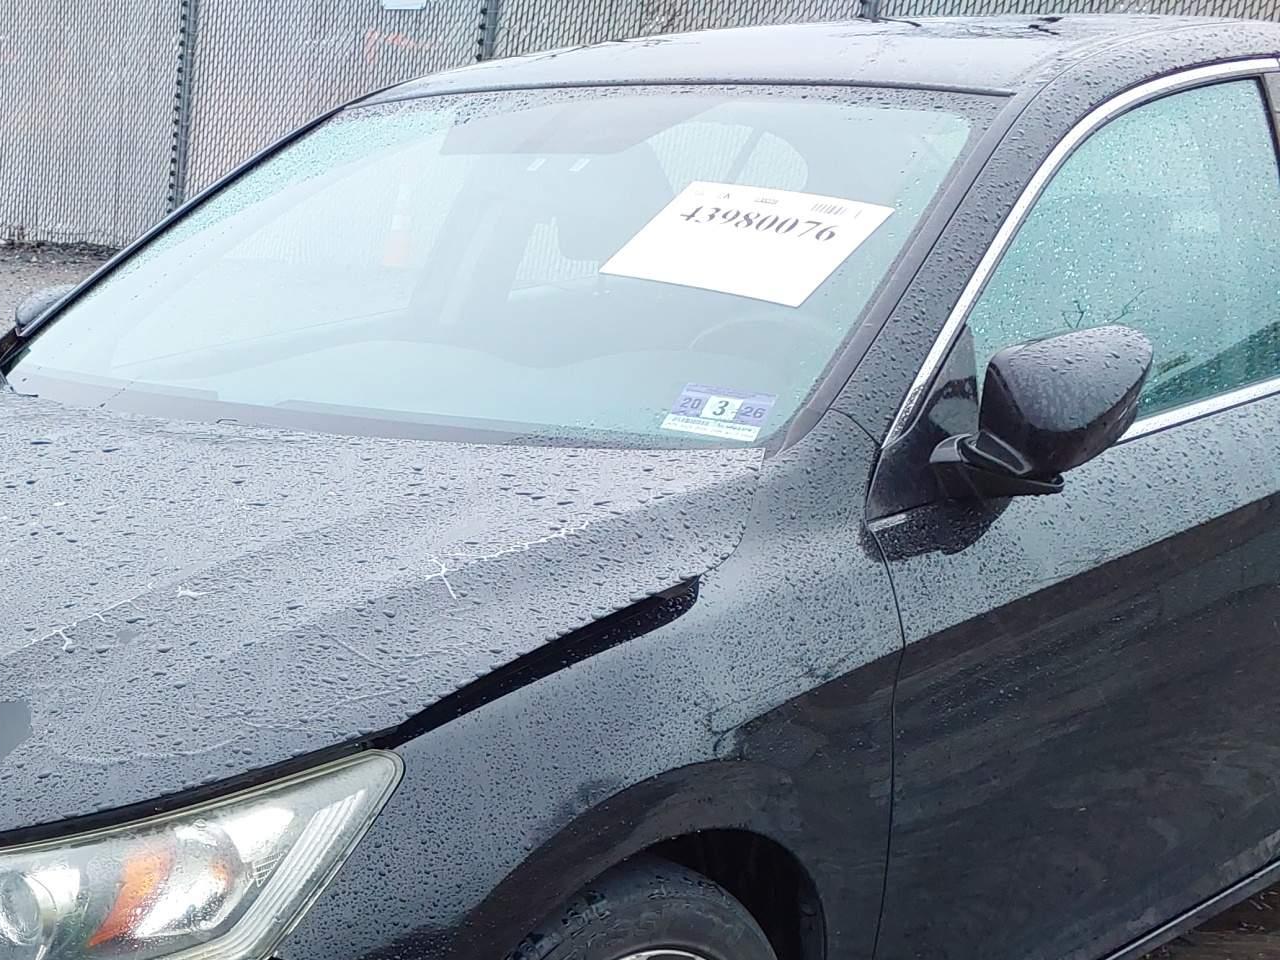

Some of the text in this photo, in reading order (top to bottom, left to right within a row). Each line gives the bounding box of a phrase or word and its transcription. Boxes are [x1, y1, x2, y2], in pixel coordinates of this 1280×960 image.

[680, 206, 838, 241] 43980076
[680, 397, 766, 418] 20 3 26
